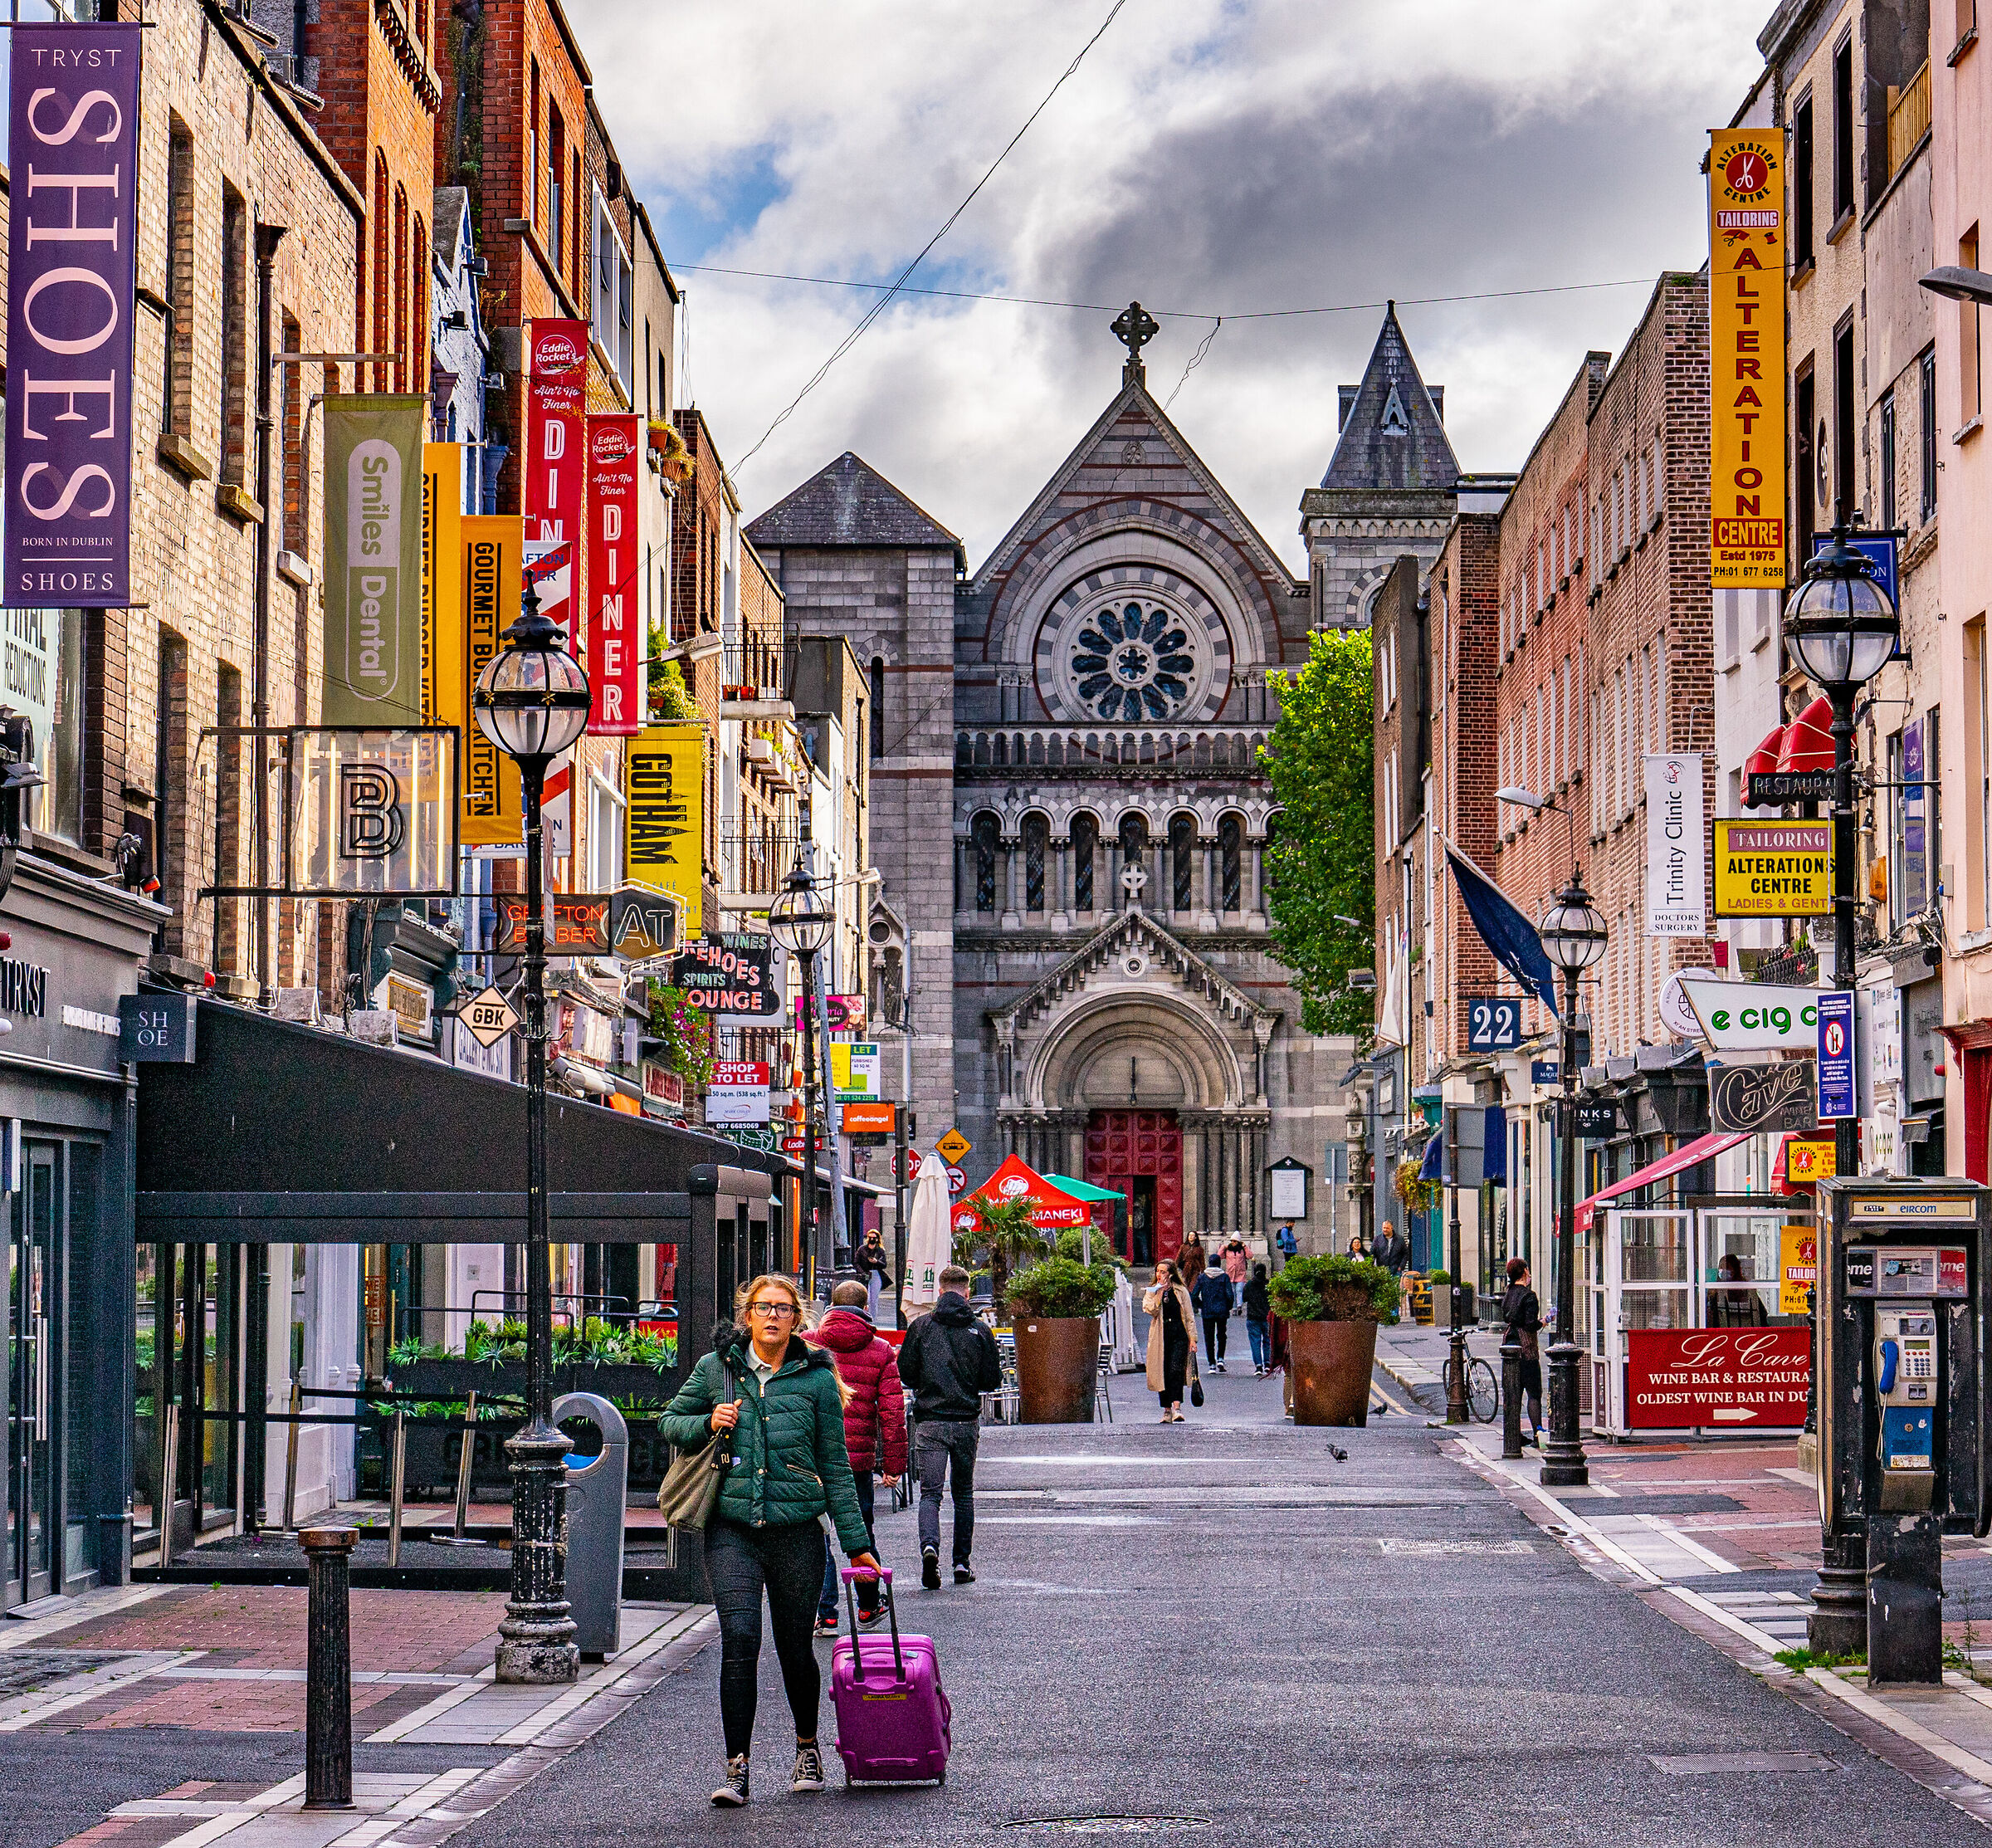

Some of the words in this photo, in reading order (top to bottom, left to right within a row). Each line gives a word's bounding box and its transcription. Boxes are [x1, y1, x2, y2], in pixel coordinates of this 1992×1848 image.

[31, 49, 122, 66] TRYST
[1716, 142, 1778, 170] ALTERATION
[1724, 186, 1771, 203] CENTRE
[1719, 213, 1777, 227] TAILORING
[21, 87, 123, 521] SHOES
[535, 350, 576, 363] Rocket's
[542, 343, 570, 354] Eddie
[1733, 248, 1763, 516] ALTERATION
[542, 398, 572, 409] Finer
[593, 442, 627, 453] Rocket's
[598, 435, 622, 445] Eddie
[593, 473, 617, 483] Ain't
[618, 474, 633, 483] No
[600, 485, 626, 496] Finer
[1718, 521, 1778, 545] CENTRE
[22, 537, 53, 546] BORN
[57, 537, 68, 546] IN
[72, 537, 113, 546] DUBLIN
[1721, 550, 1745, 561] Estd
[1750, 550, 1775, 561] 1975
[1714, 566, 1738, 576] PH:01
[1743, 566, 1758, 576] 677
[1763, 566, 1784, 576] 6258
[22, 573, 114, 590] SHOES
[474, 542, 494, 637] GOURMET
[603, 504, 622, 721] DINER
[5, 640, 46, 707] REDUCTIONS
[631, 753, 694, 864] GOTHAM
[1666, 791, 1682, 839] Clinic
[1736, 833, 1825, 847] TAILORING
[1667, 848, 1687, 904] Trinity
[1750, 878, 1812, 894] CENTRE
[1728, 899, 1773, 908] LADIES
[1778, 899, 1786, 907] &
[614, 904, 671, 947] AT
[514, 926, 597, 943] BBER
[722, 935, 768, 949] WINES
[3, 956, 51, 1017] TRYST
[683, 973, 725, 986] SPIRITS
[688, 990, 762, 1010] OUNGE
[139, 1011, 167, 1027] SH
[473, 1008, 505, 1025] GBK
[1473, 1005, 1513, 1044] 22
[1711, 1010, 1730, 1030] e
[1740, 1007, 1791, 1034] cig
[720, 1063, 755, 1073] SHOP
[715, 1074, 733, 1083] TO
[737, 1074, 759, 1083] LET
[891, 1160, 921, 1171] SOP
[1032, 1208, 1082, 1220] MANEKI
[1788, 1269, 1815, 1278] TAILOR
[1671, 1335, 1728, 1367] La
[1735, 1334, 1808, 1366] Cave
[1648, 1373, 1687, 1384] WINE
[1691, 1373, 1720, 1384] BAR
[1723, 1373, 1733, 1383] &
[1637, 1393, 1691, 1405] OLDEST
[1693, 1392, 1733, 1404] WINE
[1736, 1392, 1765, 1403] BAR
[1768, 1391, 1784, 1402] IN
